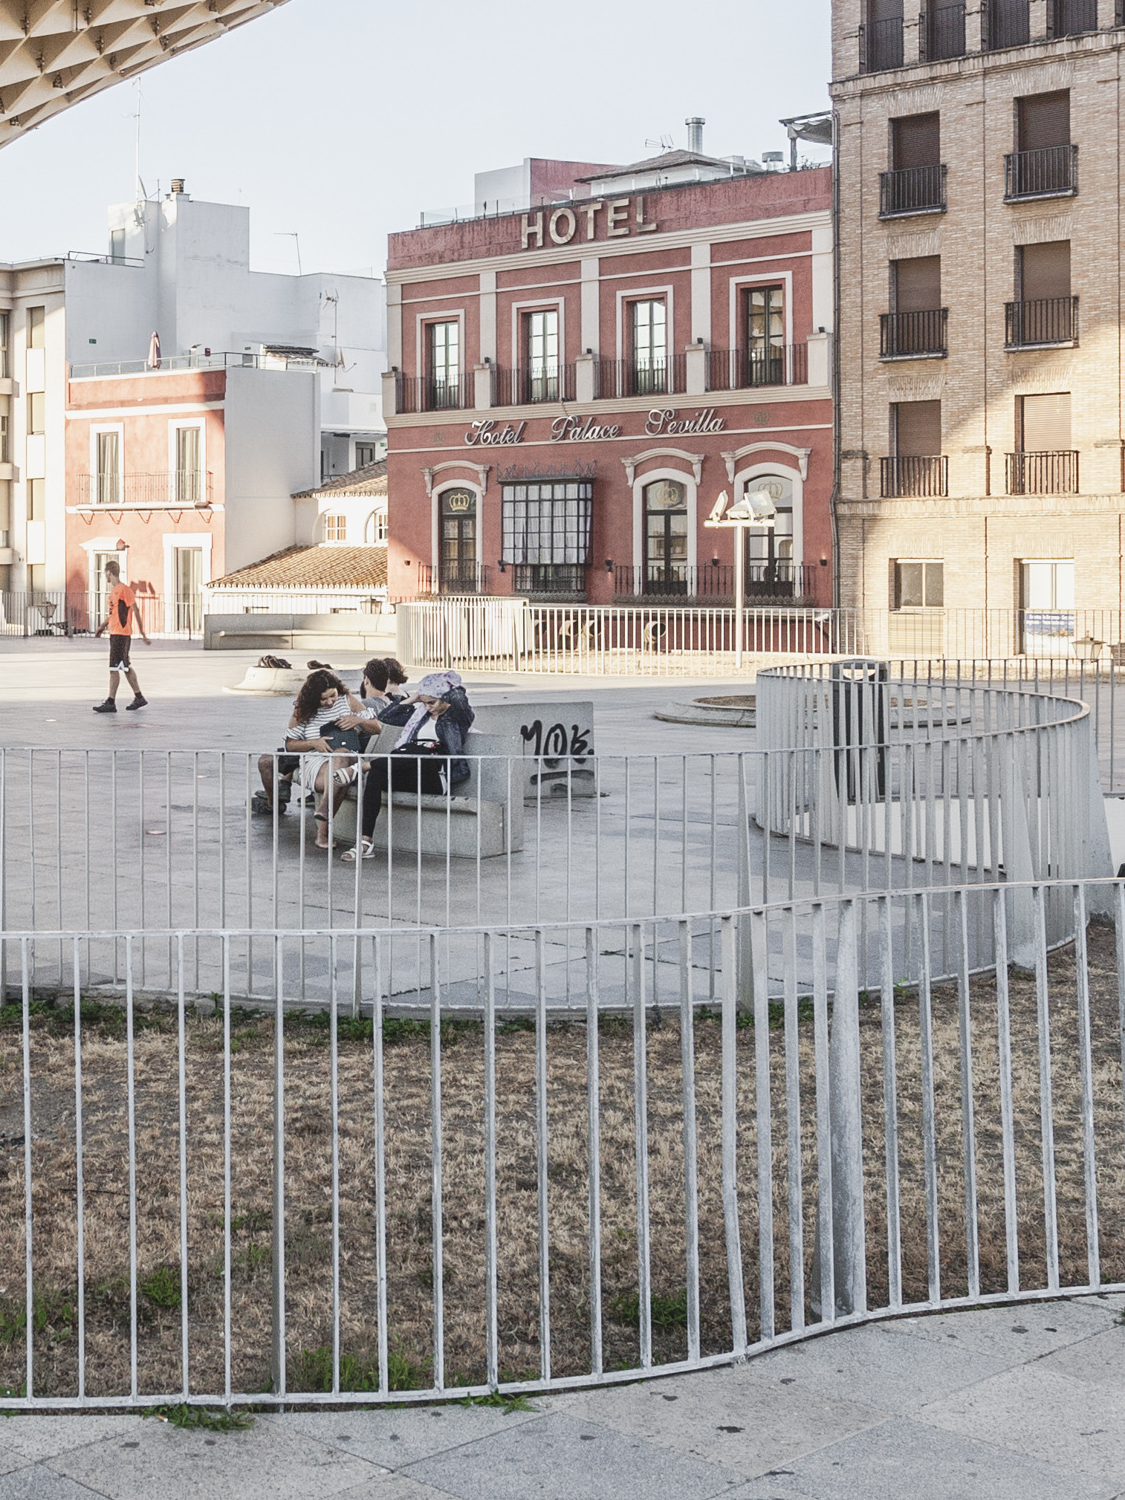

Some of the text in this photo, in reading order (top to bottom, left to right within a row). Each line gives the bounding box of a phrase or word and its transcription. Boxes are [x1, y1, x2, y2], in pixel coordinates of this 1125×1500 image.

[521, 197, 658, 249] HOTEL
[464, 408, 725, 445] Hotel Palace Sevilla
